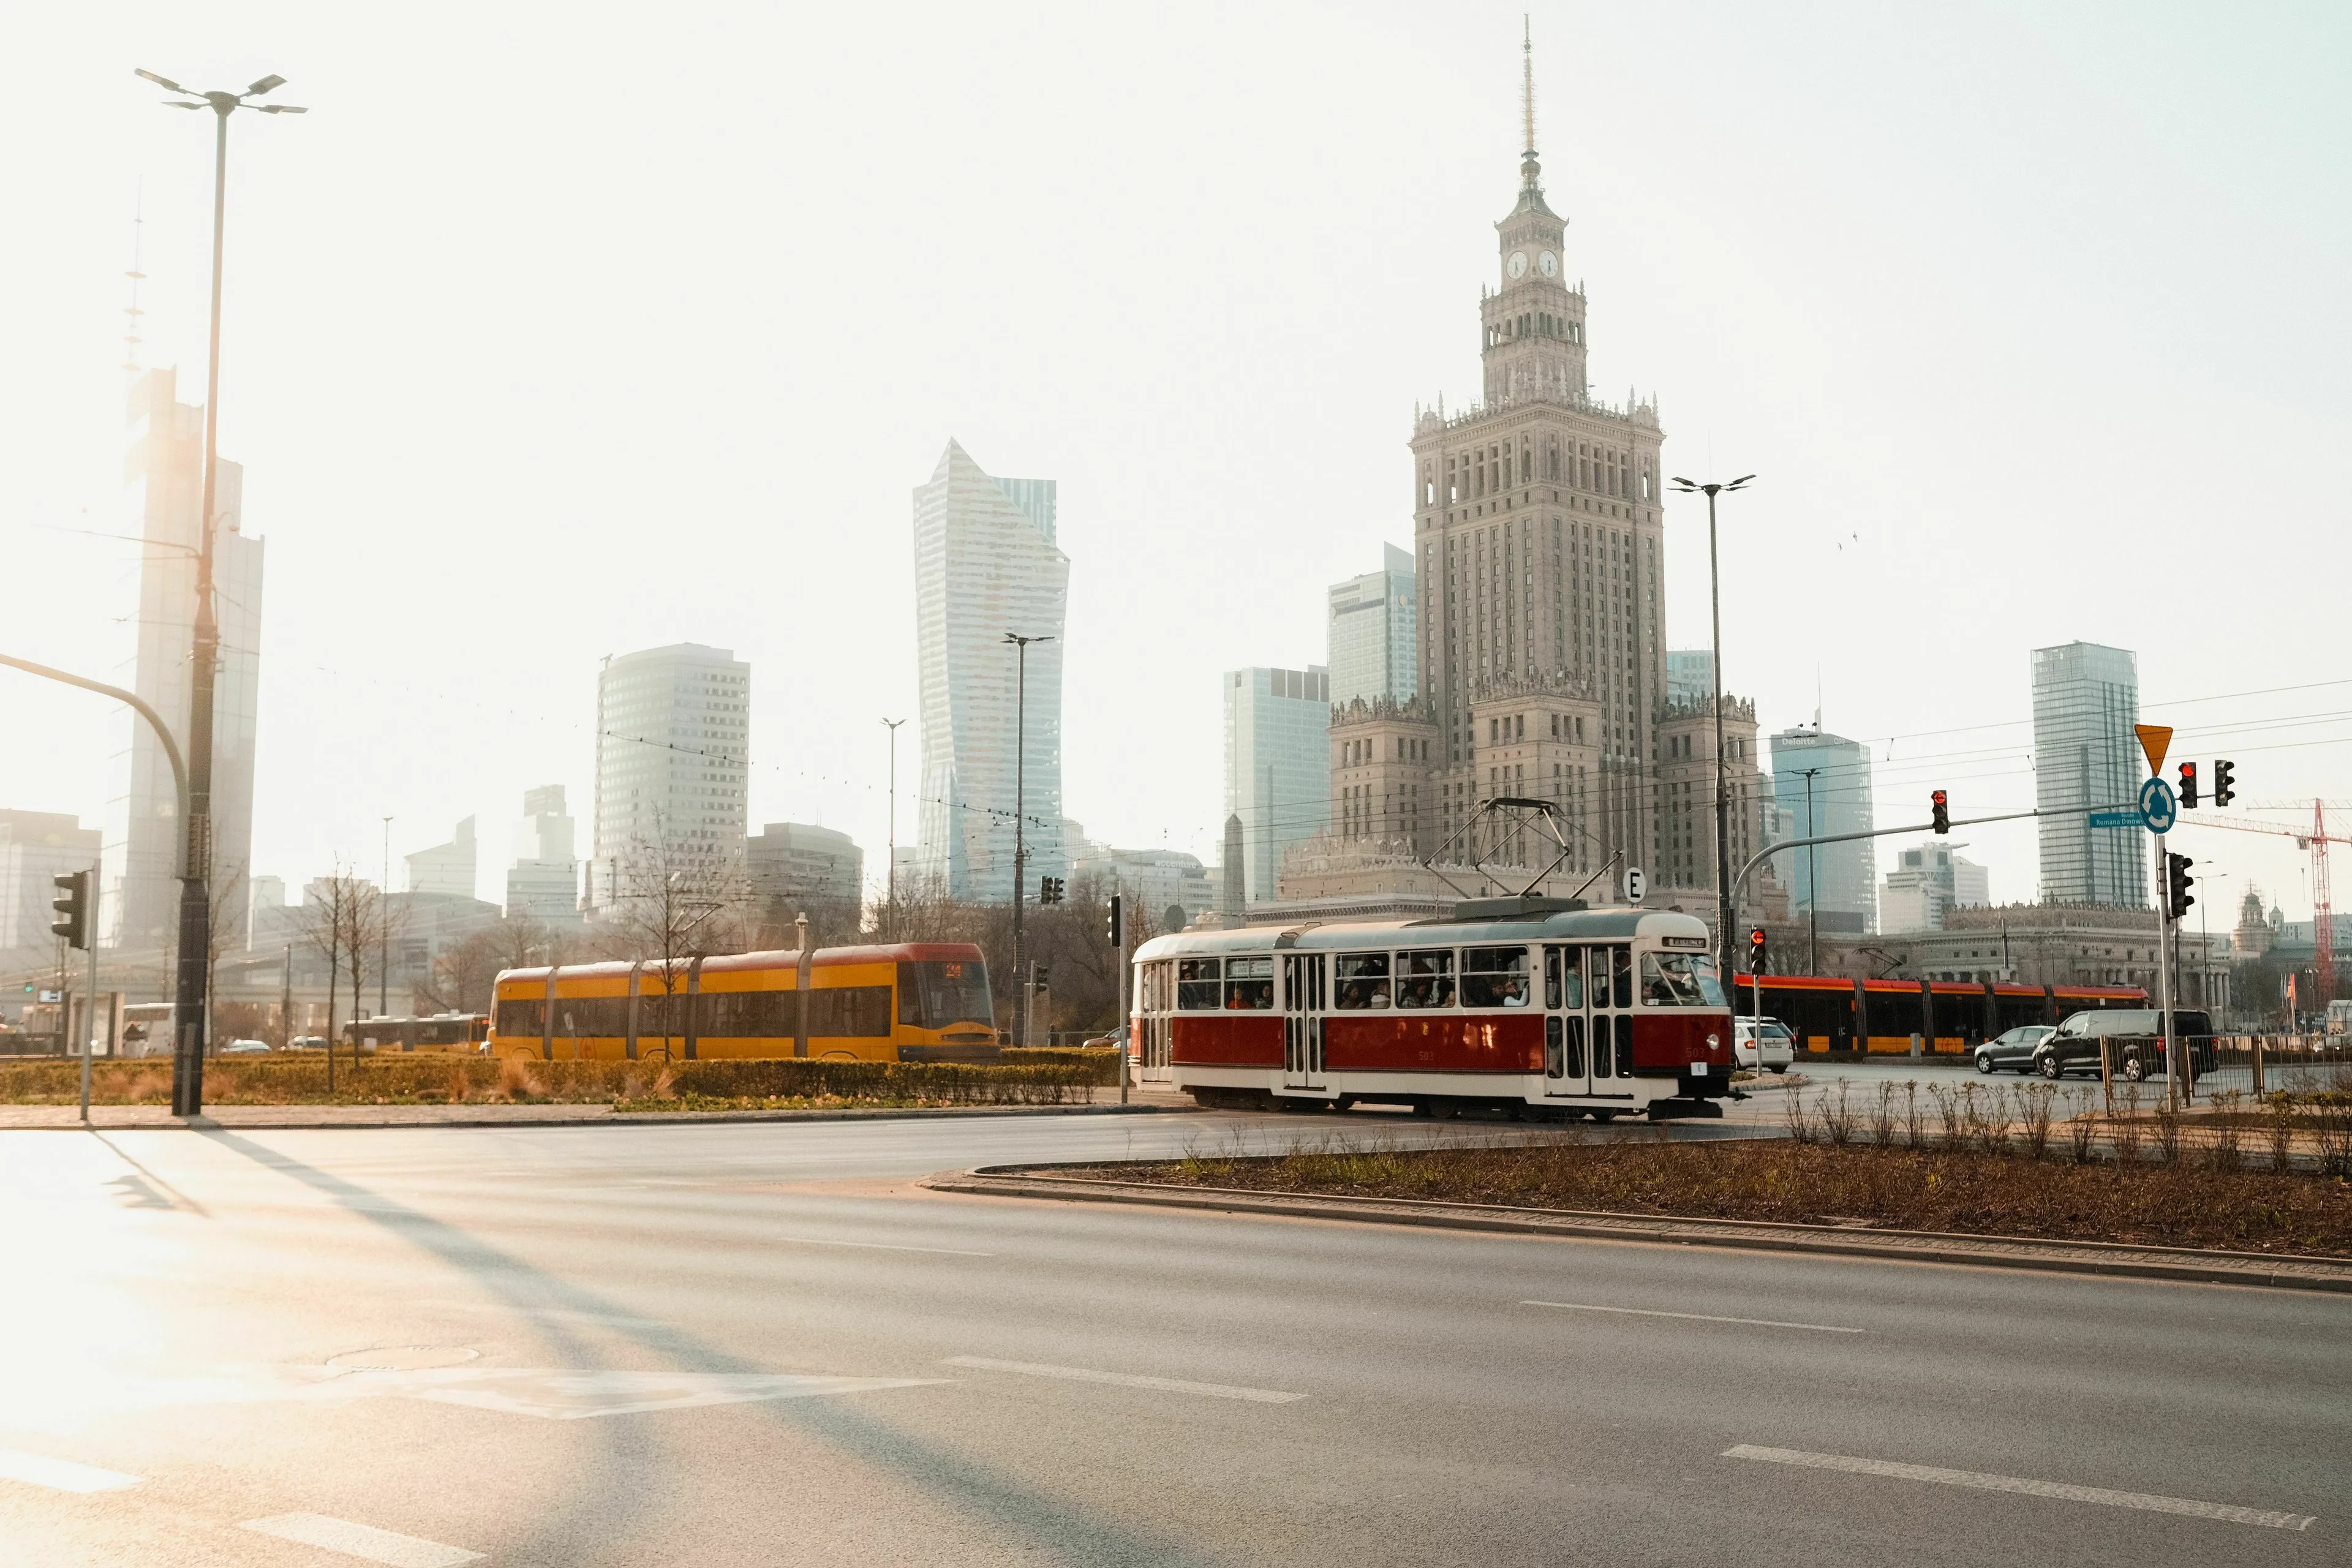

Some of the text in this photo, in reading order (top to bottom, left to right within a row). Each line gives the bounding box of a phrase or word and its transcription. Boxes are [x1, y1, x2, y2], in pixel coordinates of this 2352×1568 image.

[1155, 859, 1197, 869] accenture
[1630, 872, 1640, 898] E
[1419, 1051, 1433, 1061] 503
[1686, 1047, 1705, 1058] 503
